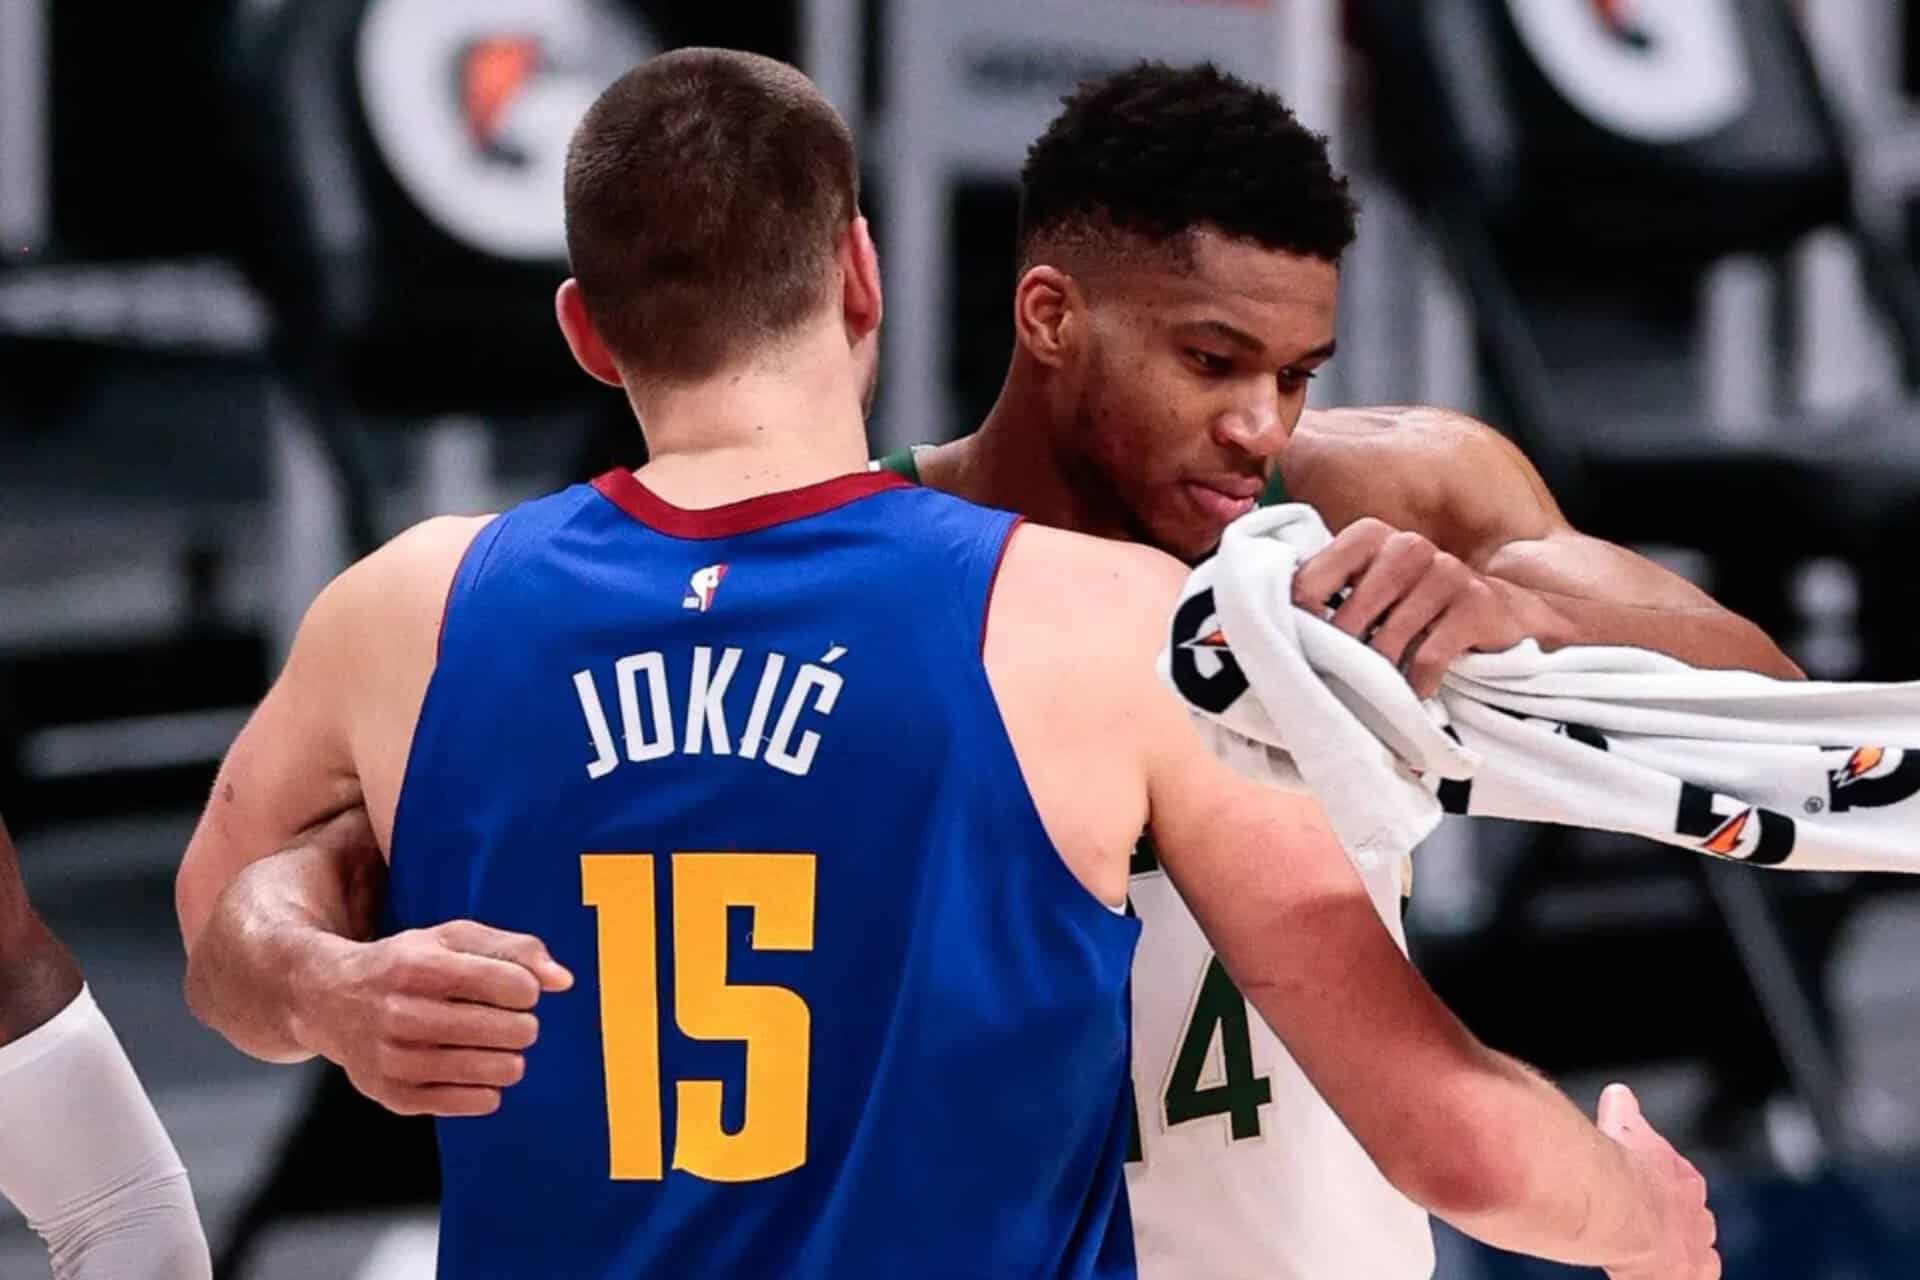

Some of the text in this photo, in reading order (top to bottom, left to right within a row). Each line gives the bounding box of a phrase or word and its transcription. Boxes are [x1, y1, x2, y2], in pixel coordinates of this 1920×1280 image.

[572, 645, 848, 779] JOKIĆ
[580, 853, 817, 1182] 15
[1126, 954, 1273, 1161] 4
